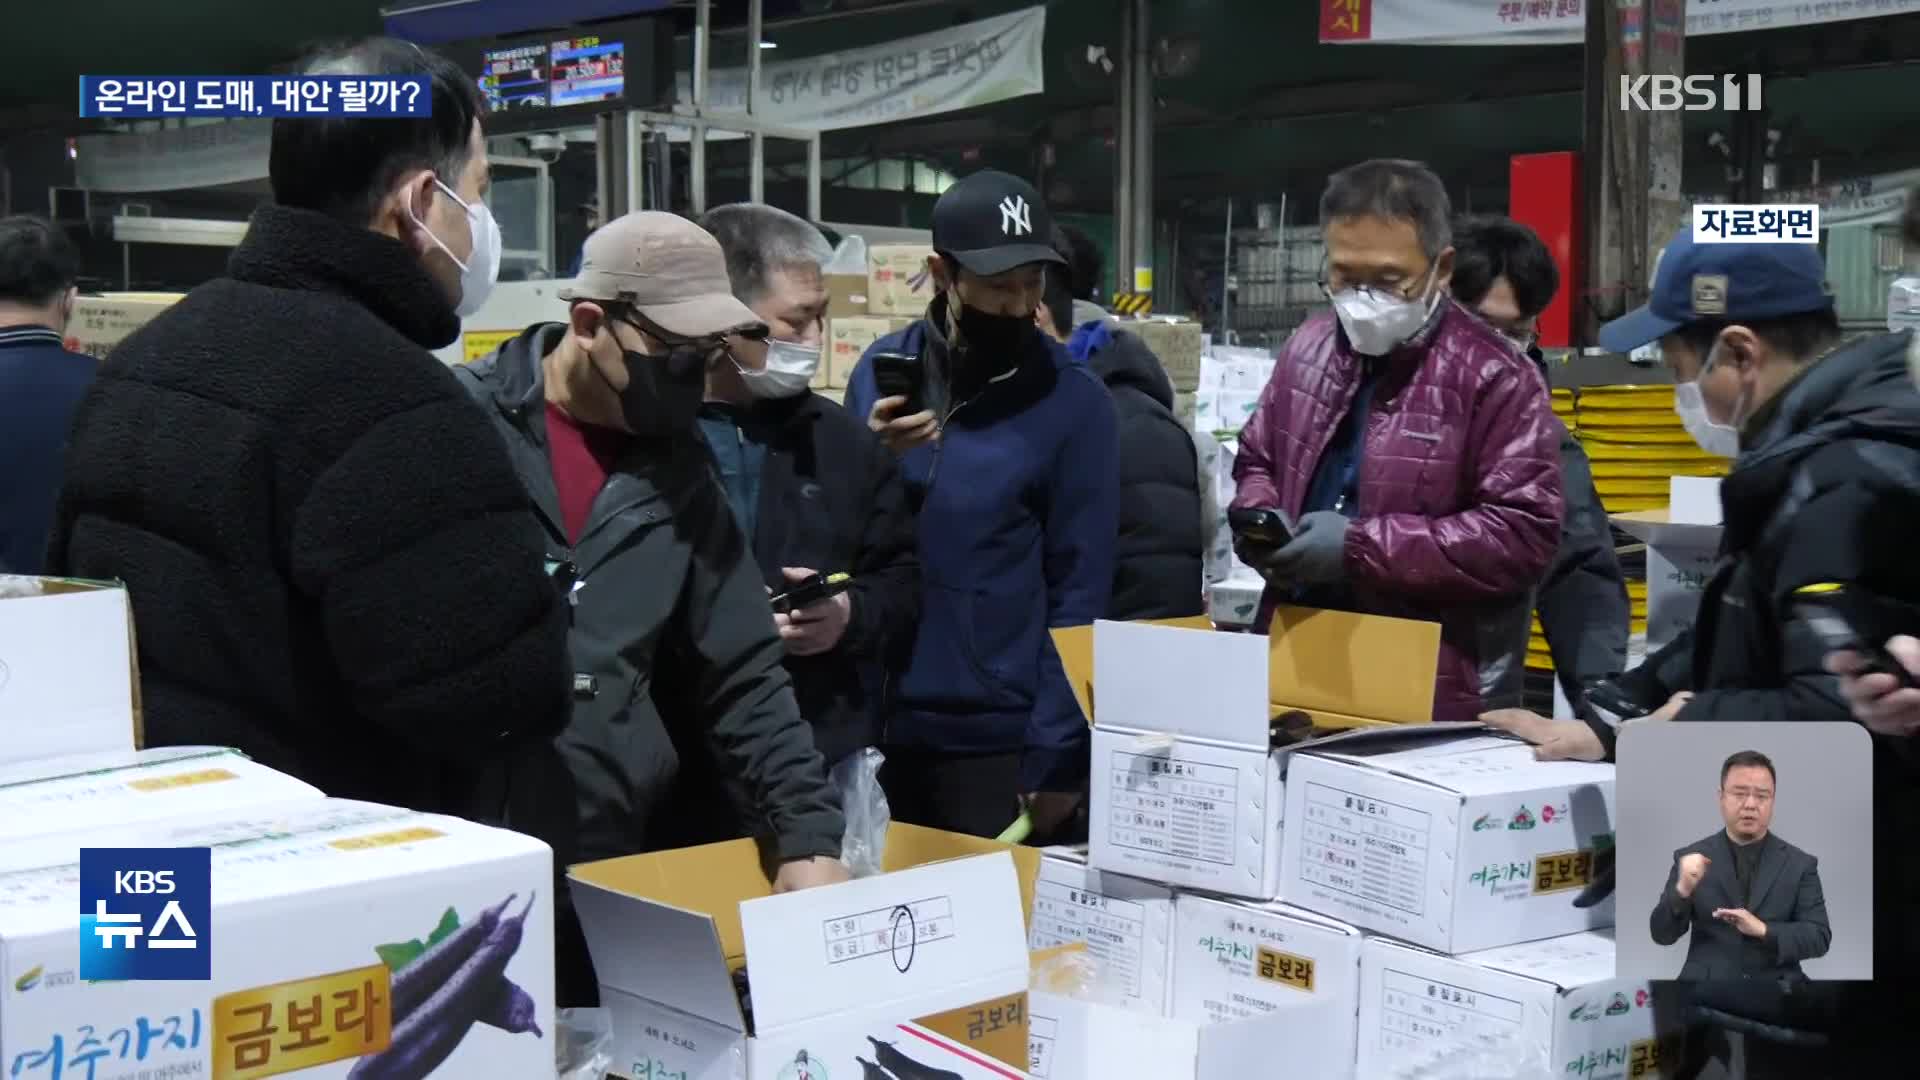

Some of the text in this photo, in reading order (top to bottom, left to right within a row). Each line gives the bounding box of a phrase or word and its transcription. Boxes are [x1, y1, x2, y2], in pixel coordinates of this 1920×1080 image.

[999, 195, 1032, 235] NY
[1258, 951, 1313, 989] 금보라
[226, 979, 382, 1071] 금보라
